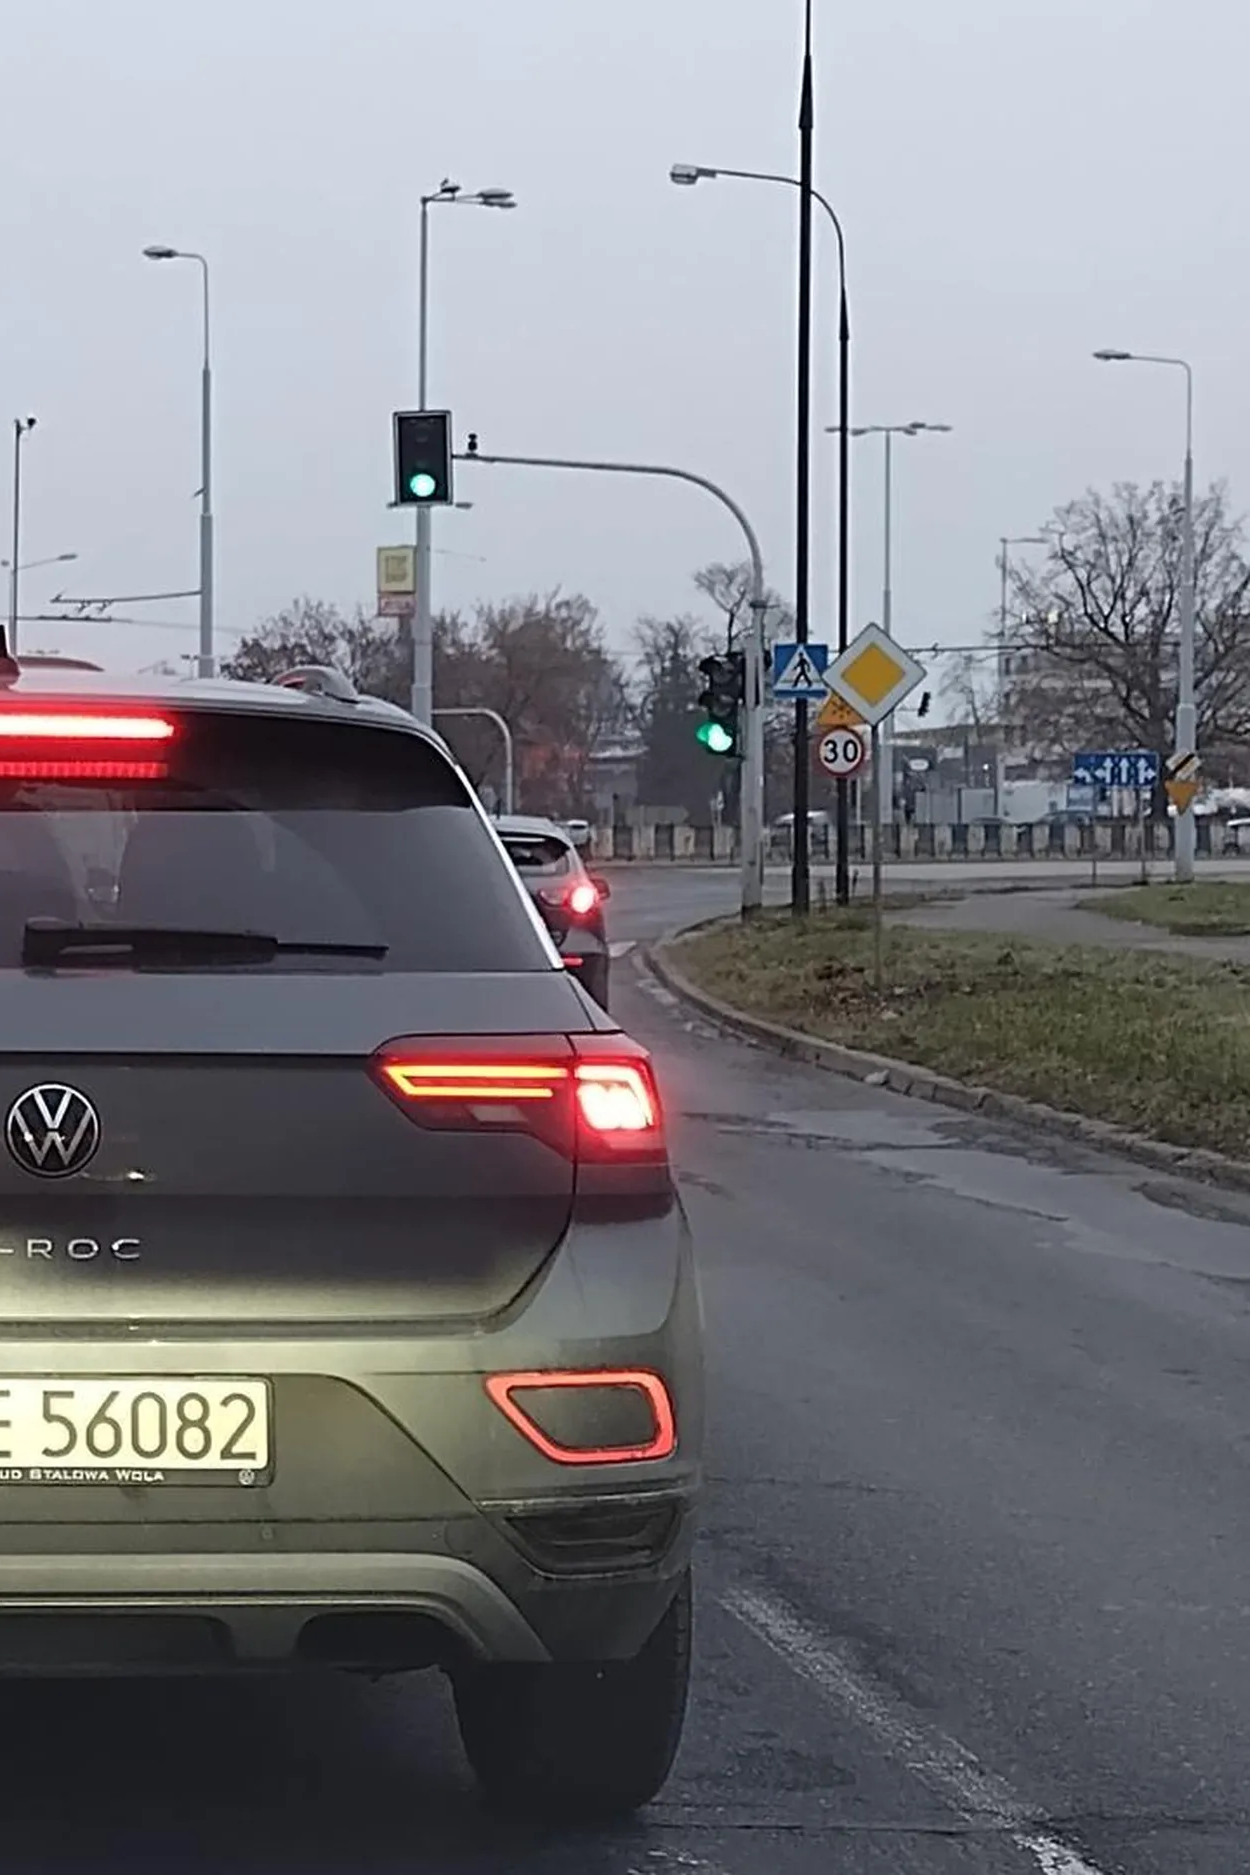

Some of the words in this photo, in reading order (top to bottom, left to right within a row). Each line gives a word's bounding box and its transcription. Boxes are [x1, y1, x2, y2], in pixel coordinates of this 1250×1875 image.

[823, 739, 859, 764] 30
[41, 1389, 257, 1461] 56082
[29, 1468, 110, 1481] STALOWA
[115, 1468, 165, 1482] WOLA
